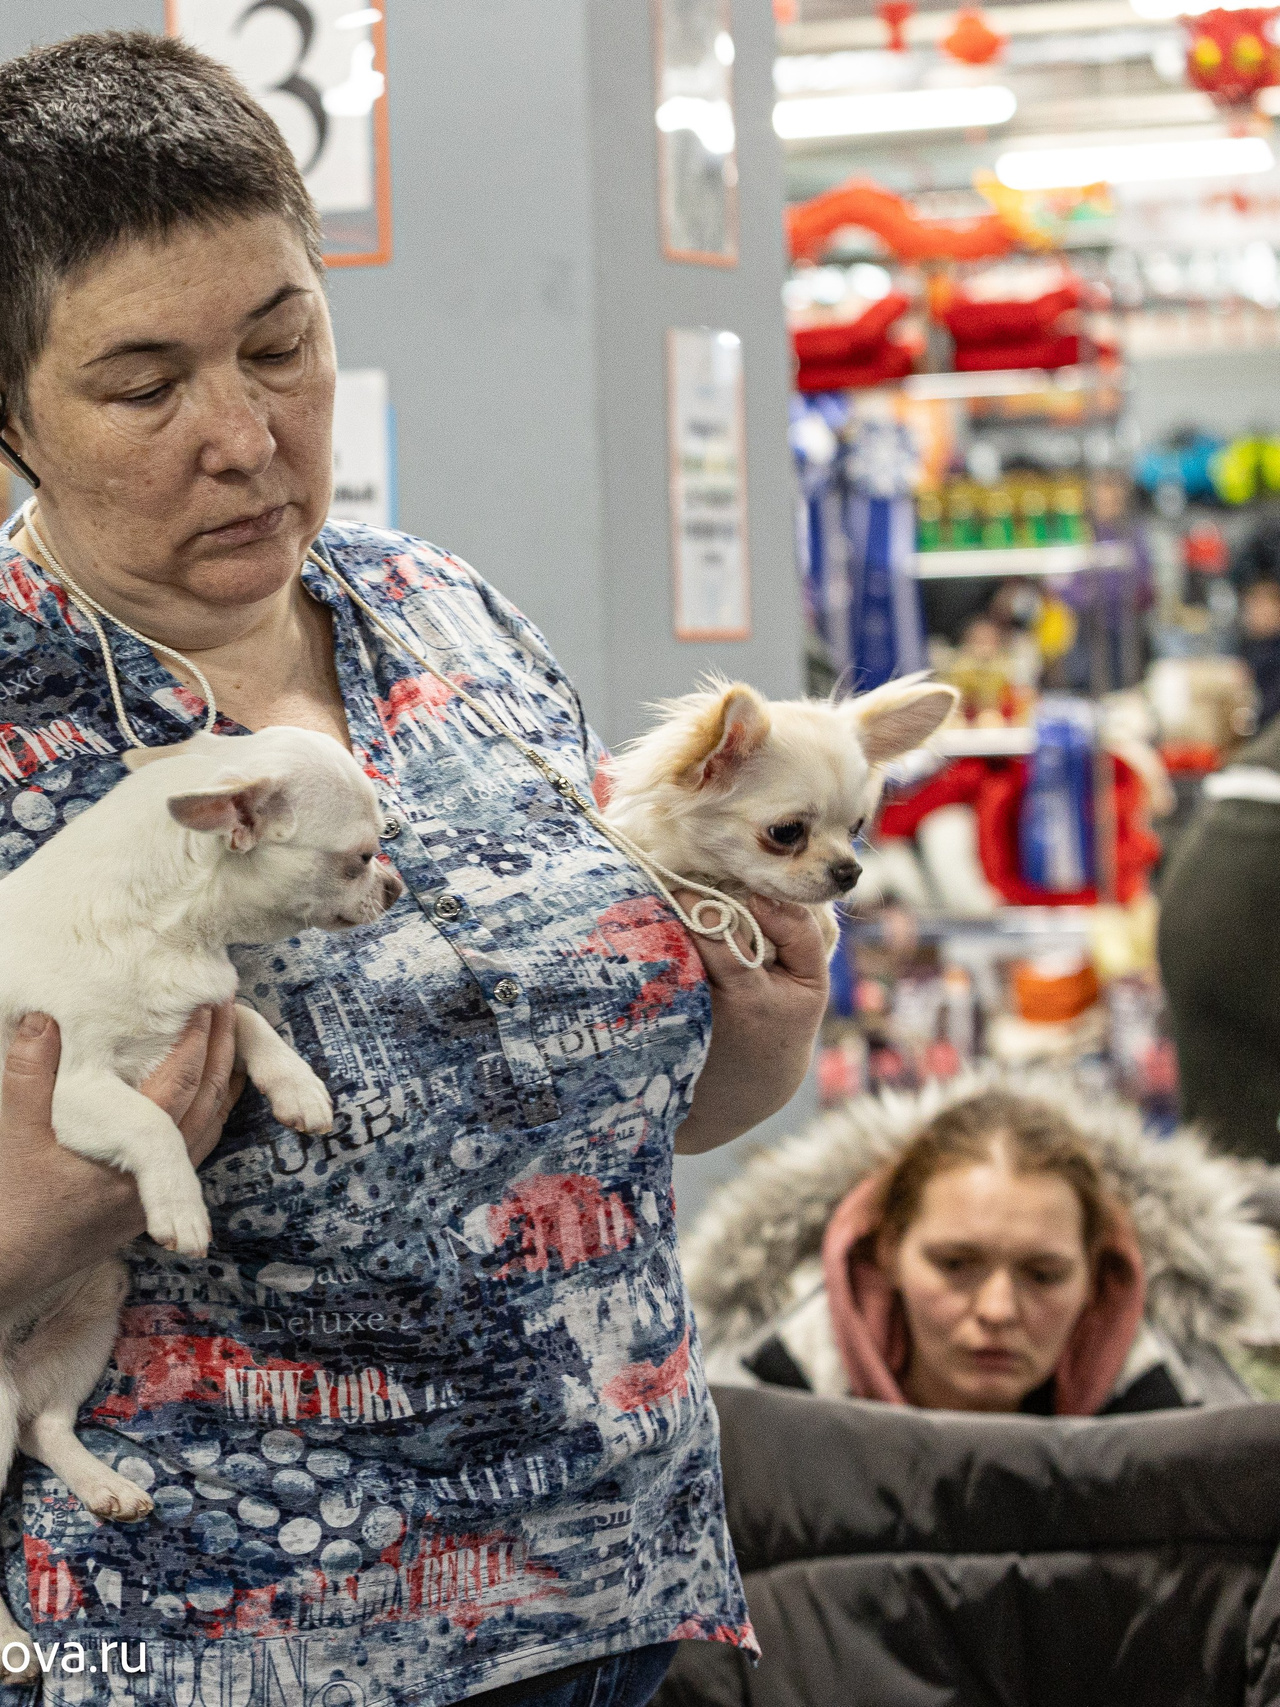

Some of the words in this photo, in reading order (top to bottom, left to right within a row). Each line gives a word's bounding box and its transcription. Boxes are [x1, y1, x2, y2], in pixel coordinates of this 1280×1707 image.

[230, 0, 329, 178] 3
[12, 718, 120, 771] YORK
[262, 1307, 388, 1336] Deluxe
[225, 1368, 303, 1425] NEW
[314, 1366, 415, 1426] YORK
